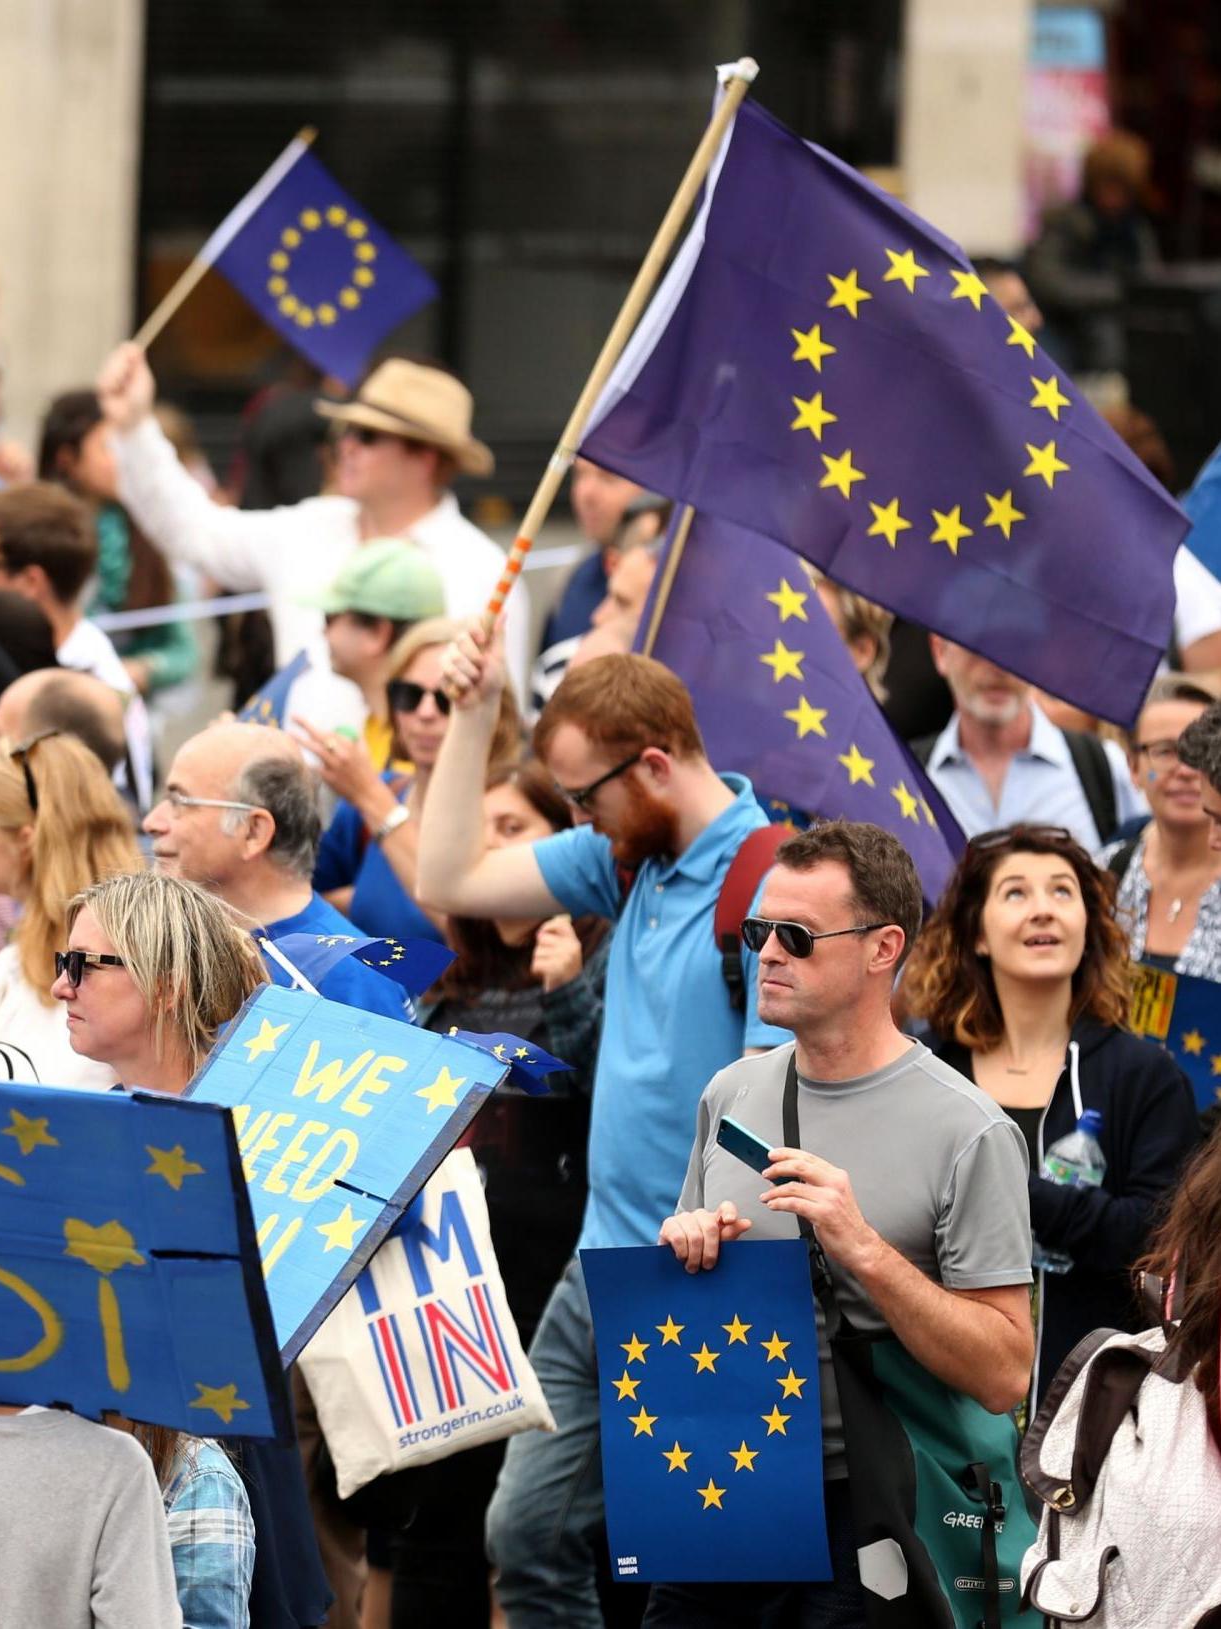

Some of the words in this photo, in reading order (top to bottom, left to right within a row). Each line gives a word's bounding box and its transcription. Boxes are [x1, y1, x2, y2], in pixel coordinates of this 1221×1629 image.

[292, 1040, 408, 1117] WE
[368, 1283, 518, 1428] IN
[398, 1394, 526, 1449] strongerin.co.uk
